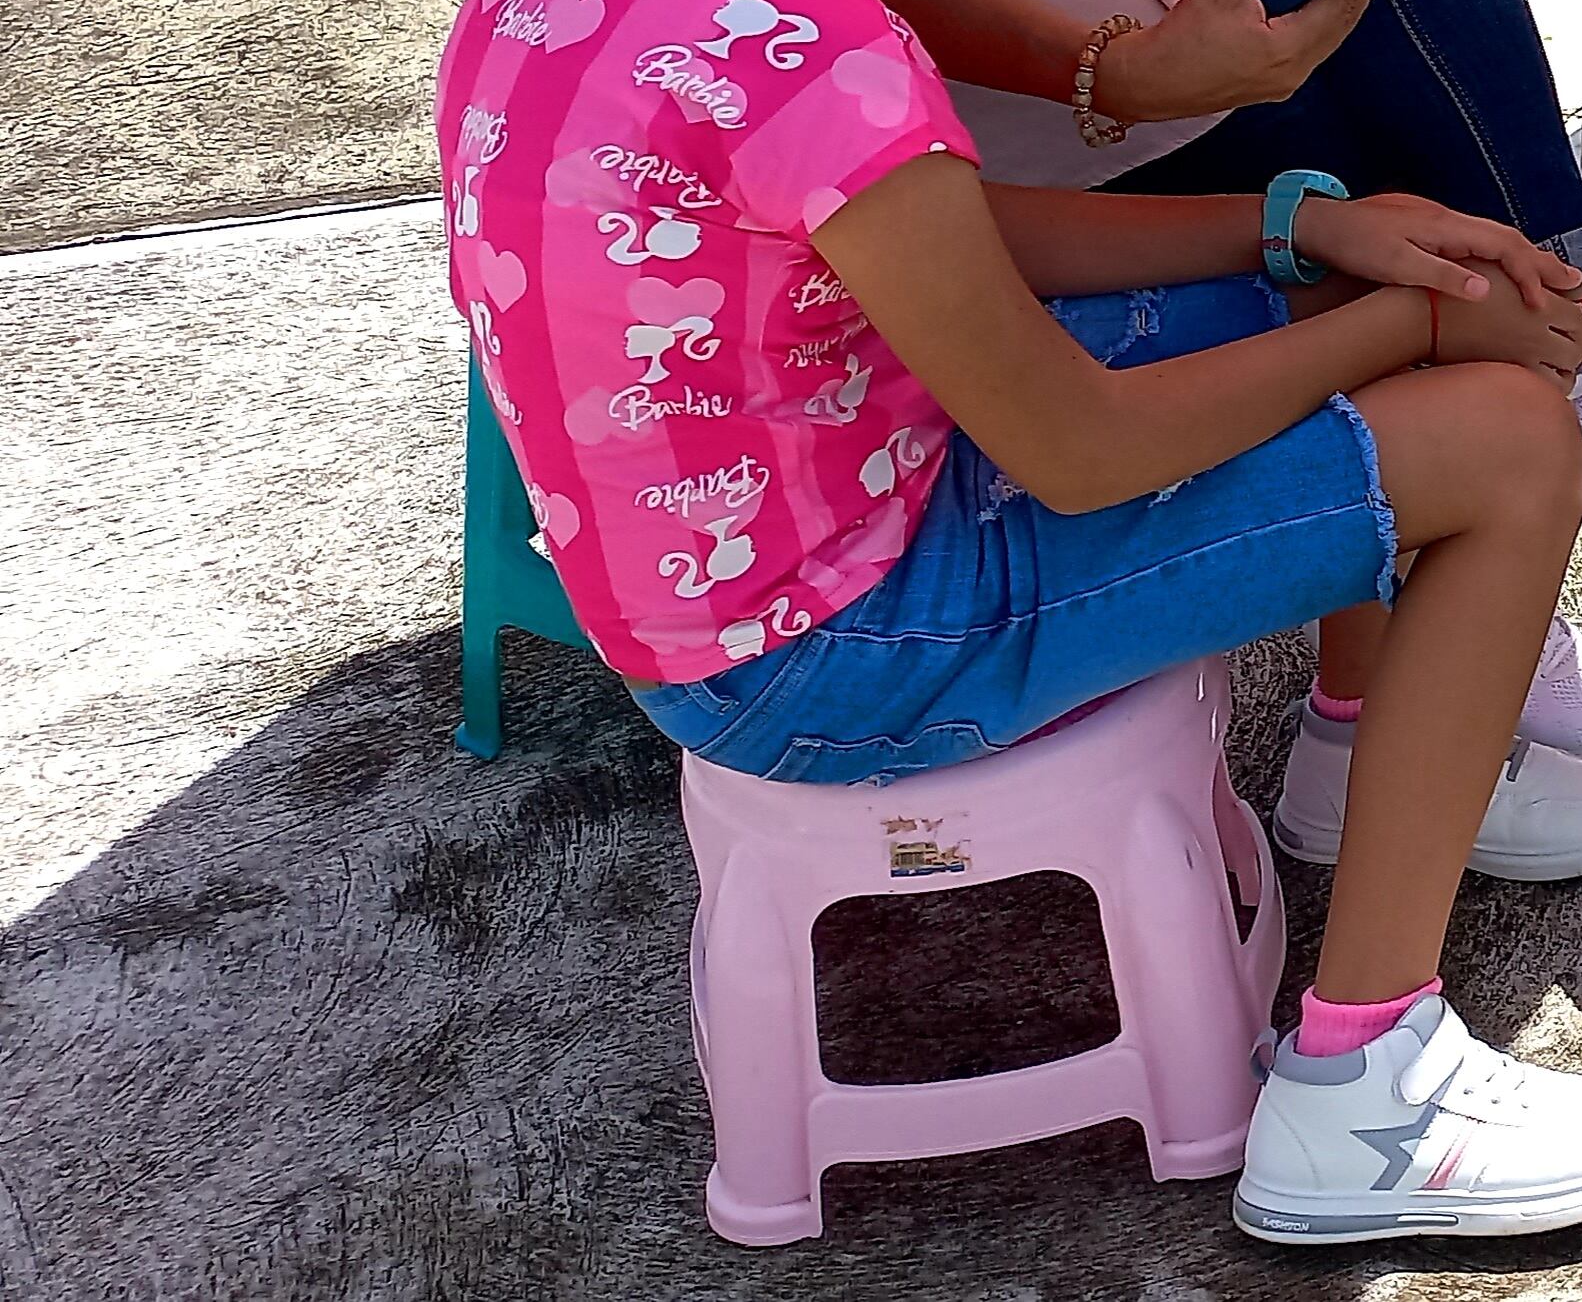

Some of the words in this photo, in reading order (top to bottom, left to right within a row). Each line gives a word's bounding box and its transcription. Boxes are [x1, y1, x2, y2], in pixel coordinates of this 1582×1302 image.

[632, 44, 748, 130] Barbie
[589, 144, 723, 209] Barbie
[609, 384, 733, 431] Barbie
[634, 454, 770, 518] Barbie
